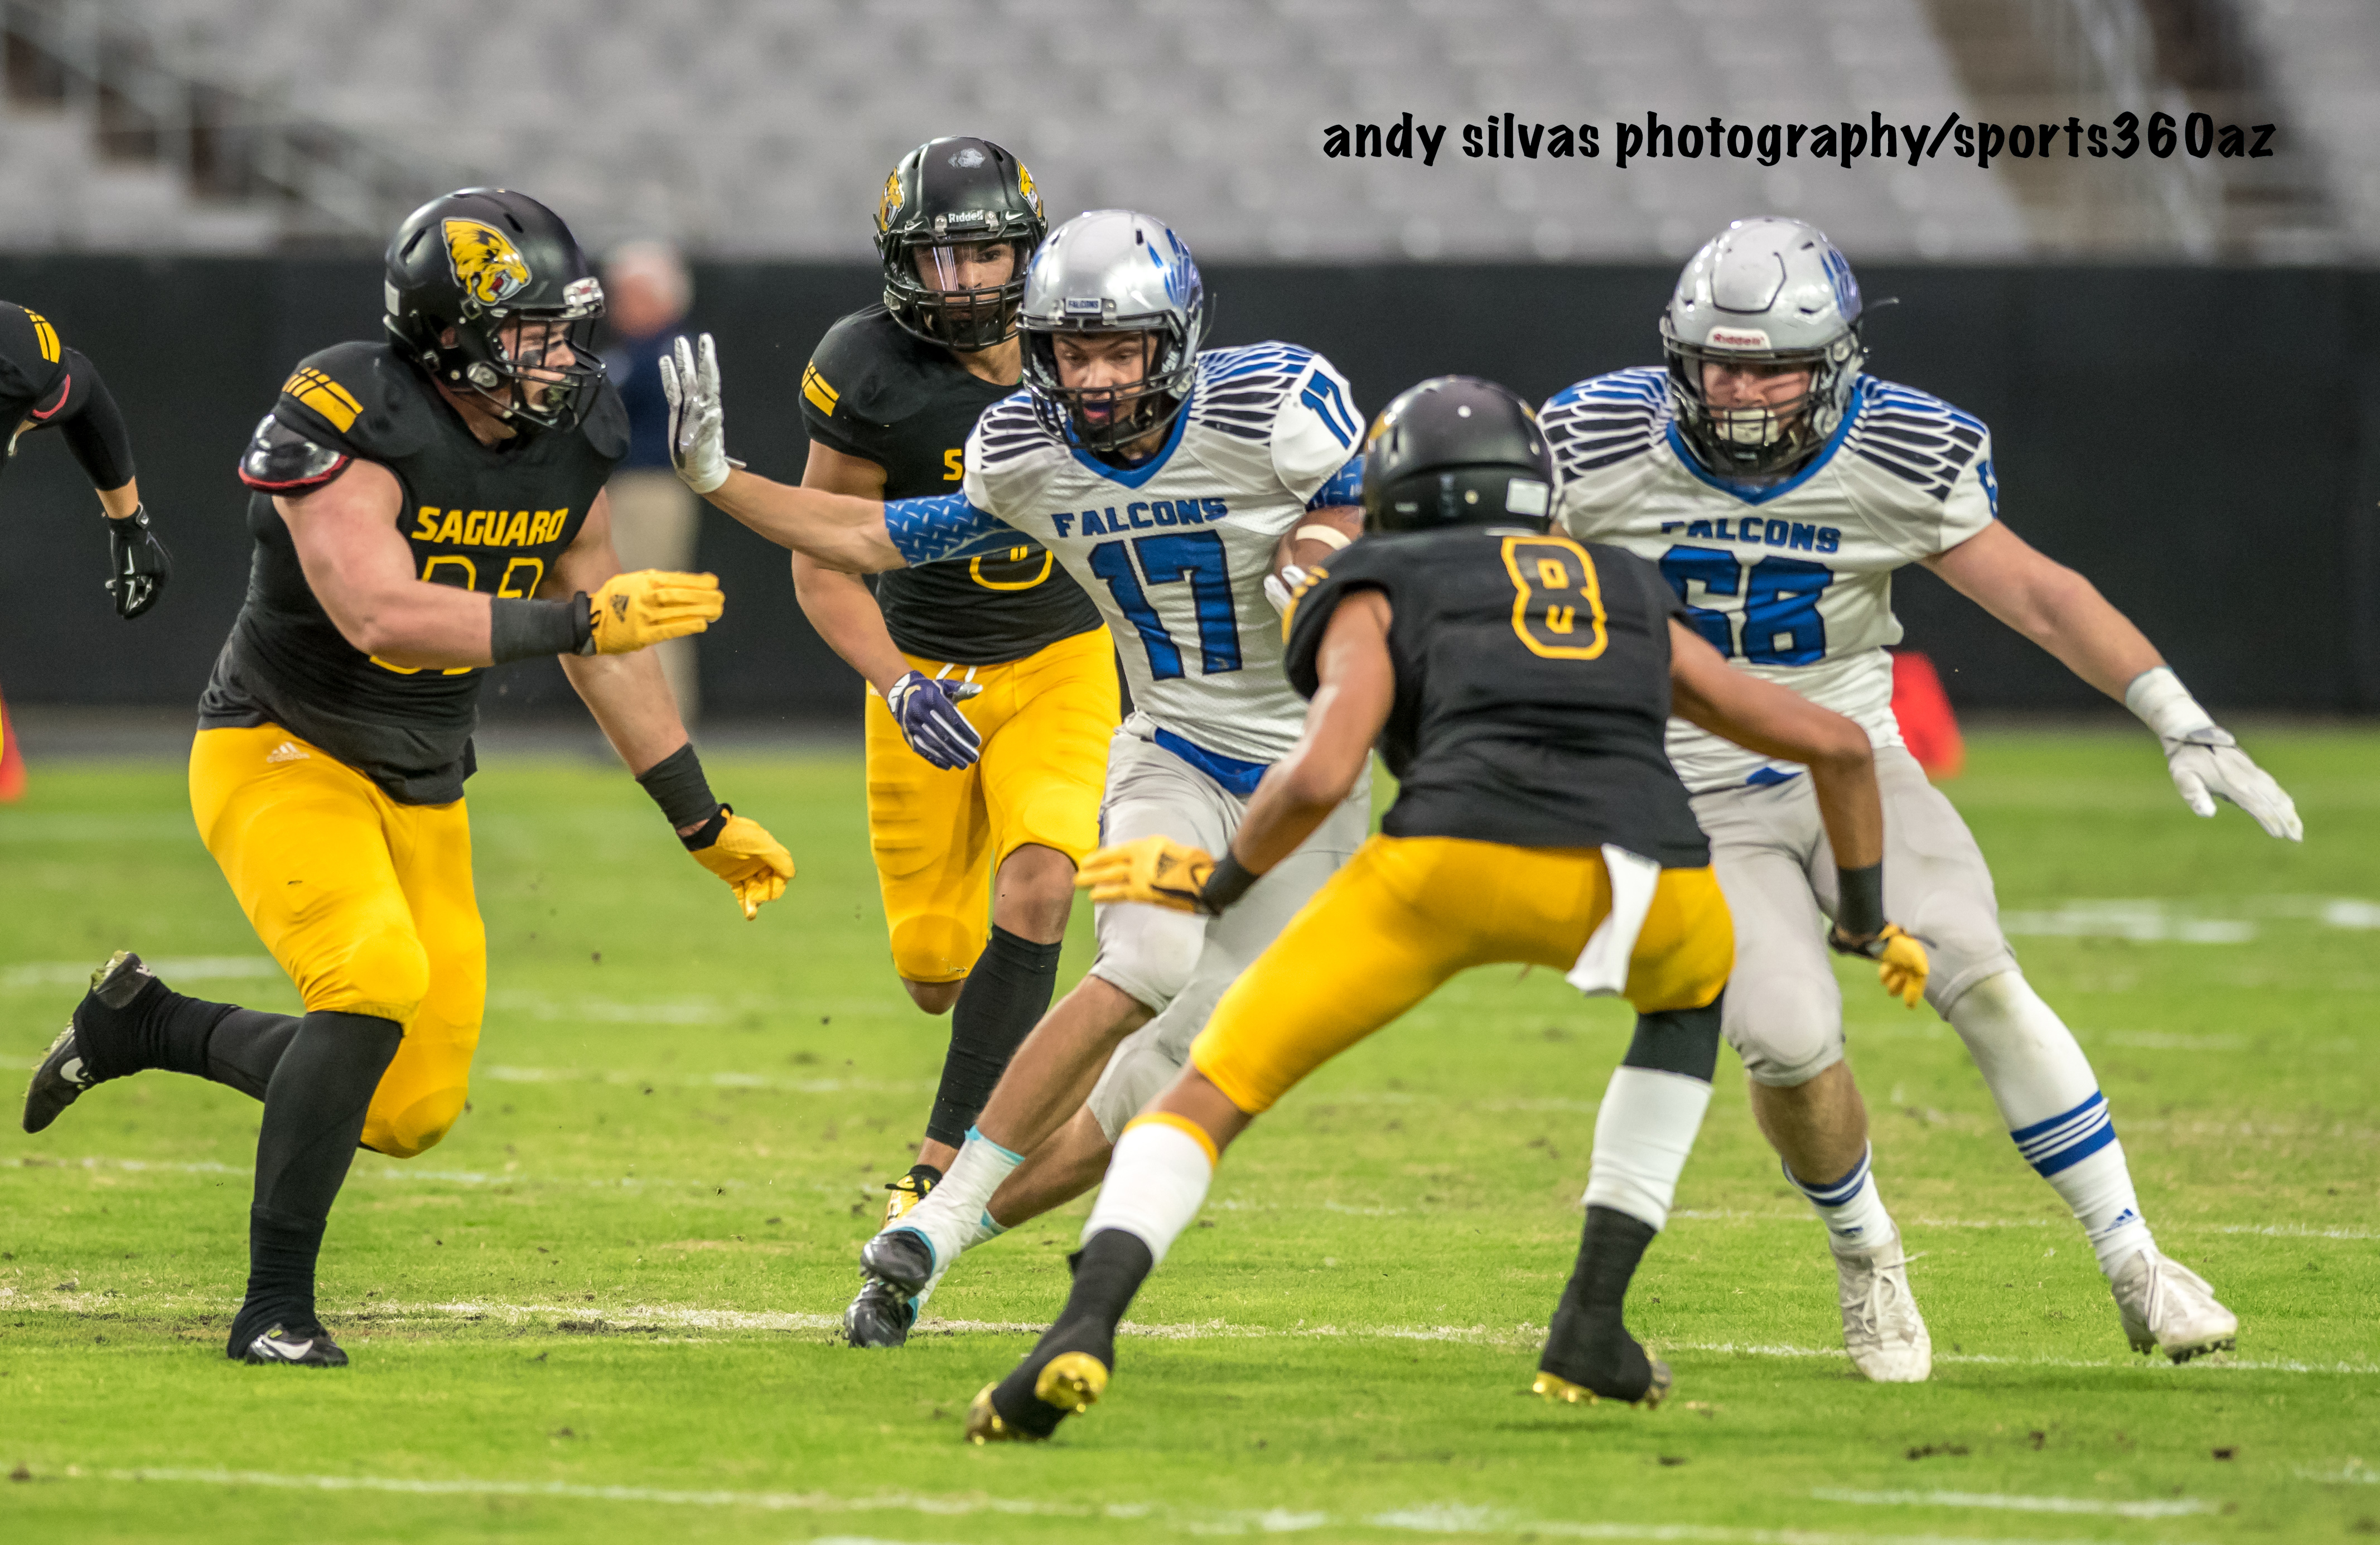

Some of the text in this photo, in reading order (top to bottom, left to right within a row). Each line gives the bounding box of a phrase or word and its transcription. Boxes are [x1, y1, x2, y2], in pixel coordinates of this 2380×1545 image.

[948, 210, 983, 223] Riddell
[1301, 369, 1357, 450] 17
[411, 505, 569, 547] SAGUARO
[1052, 497, 1228, 538] FALCONS
[1660, 516, 1841, 553] FALCONS
[1087, 530, 1242, 680] 17
[1502, 537, 1607, 660] 8
[1659, 544, 1834, 667] 68
